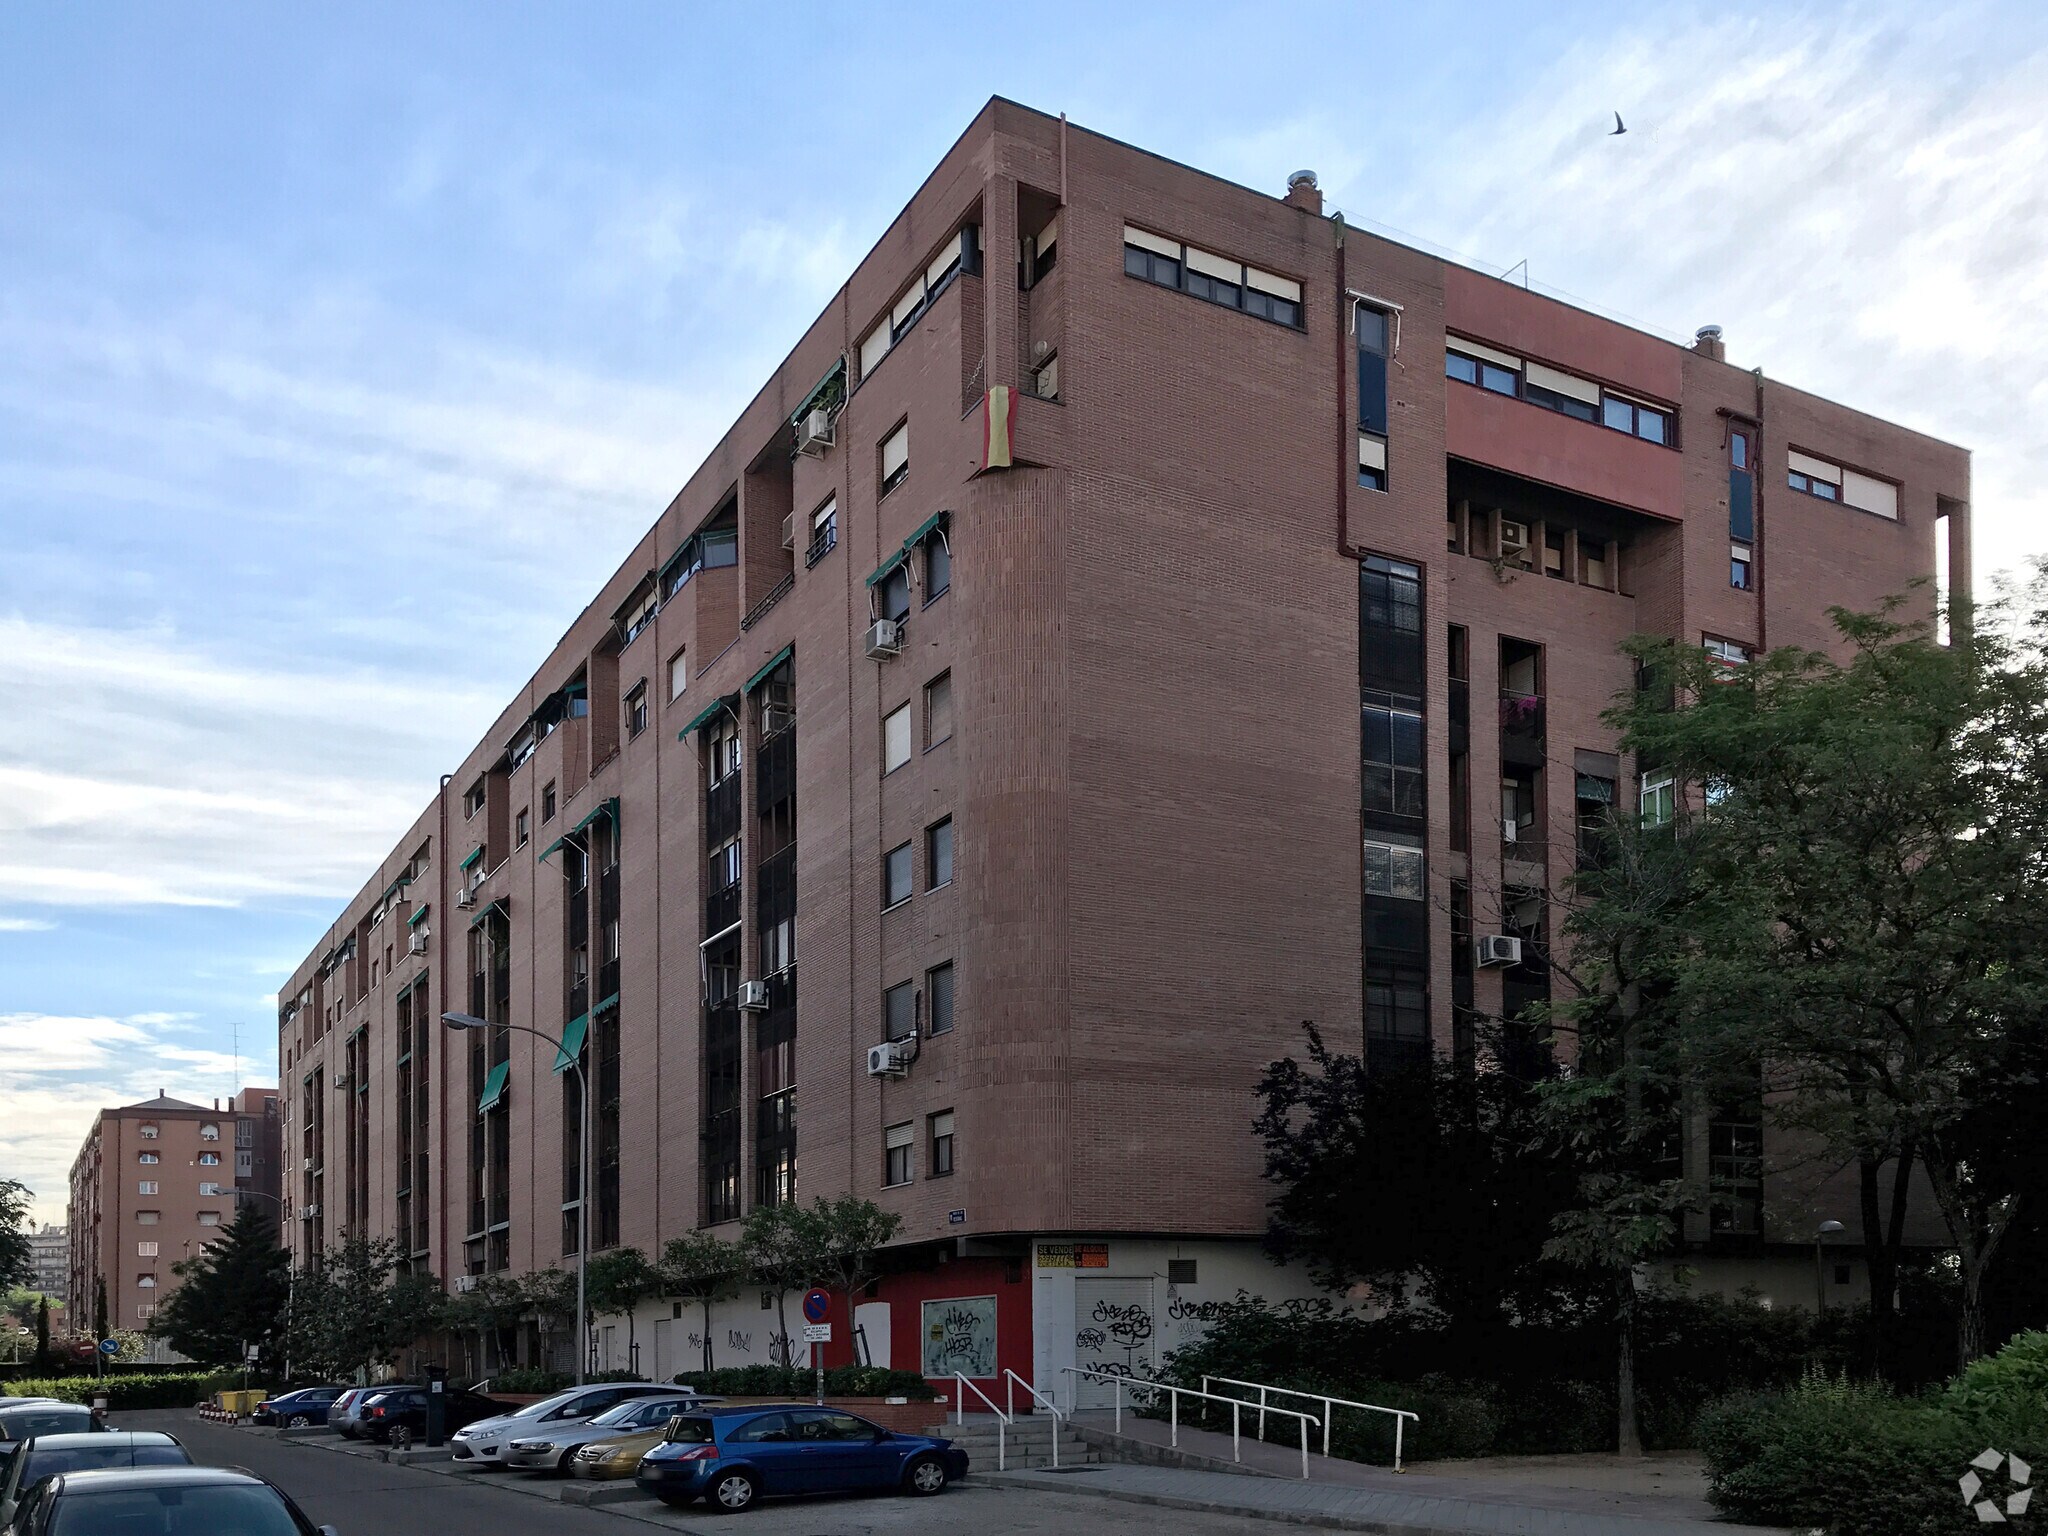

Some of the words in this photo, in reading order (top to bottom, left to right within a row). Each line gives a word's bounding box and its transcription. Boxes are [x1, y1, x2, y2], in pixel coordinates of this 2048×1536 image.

[1038, 1245, 1047, 1254] SE
[1049, 1245, 1073, 1254] VENDE
[1083, 1245, 1107, 1253] ALQUILA
